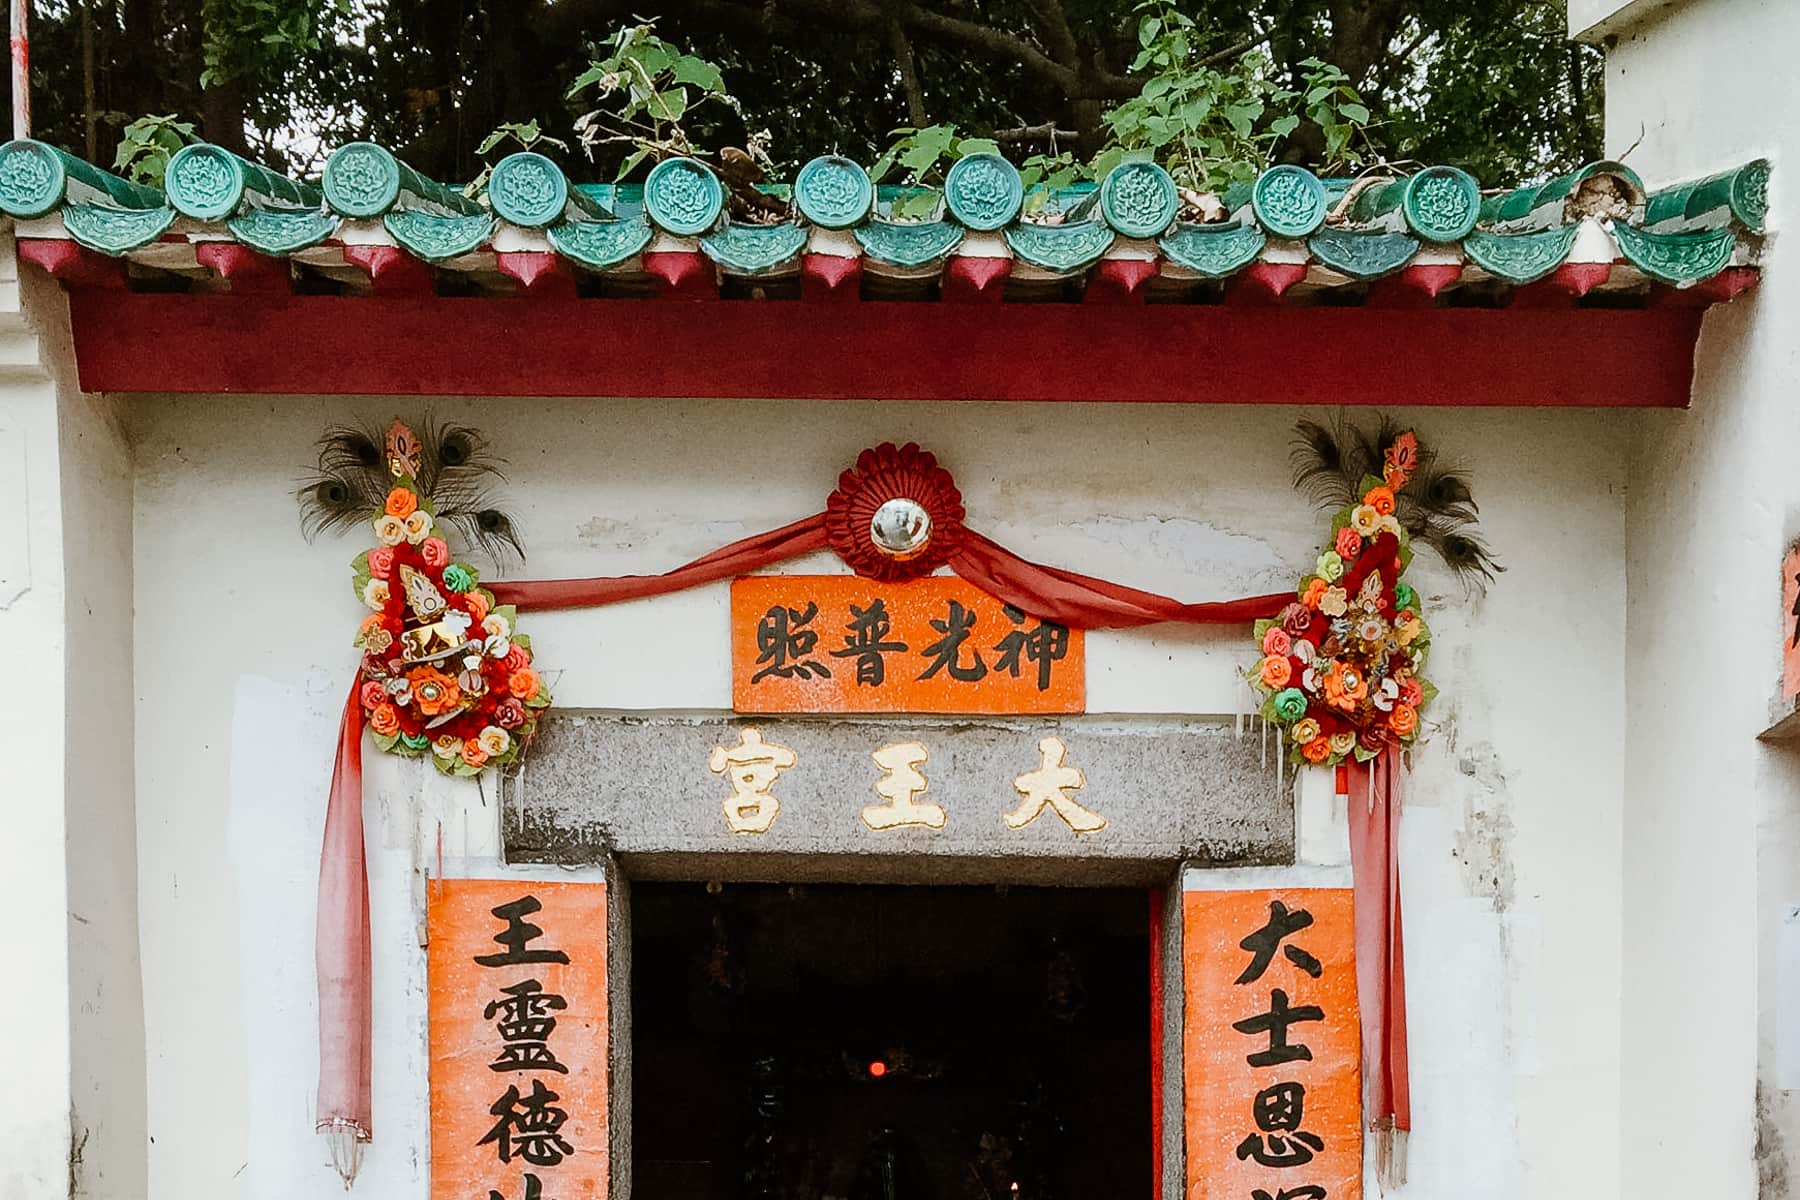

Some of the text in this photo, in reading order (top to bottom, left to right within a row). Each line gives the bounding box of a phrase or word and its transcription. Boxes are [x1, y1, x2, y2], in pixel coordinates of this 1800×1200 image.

[751, 599, 1069, 692] 神光普照
[708, 726, 1109, 834] 大王宮
